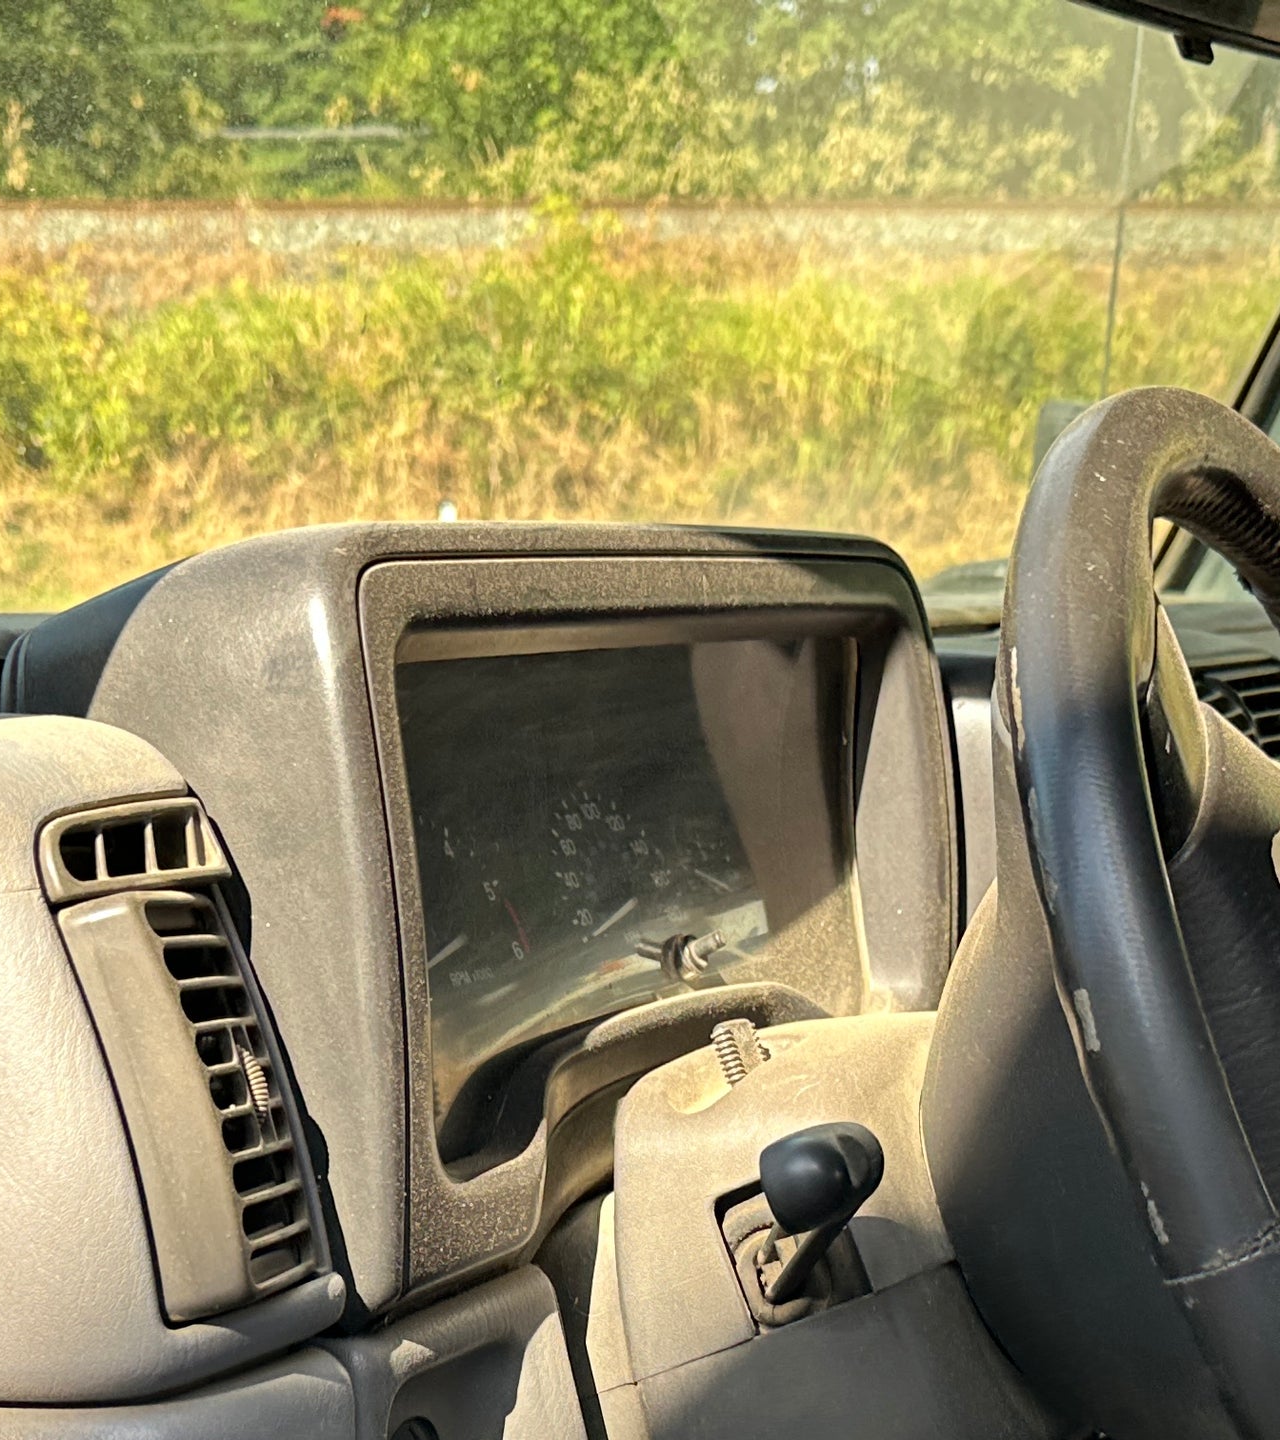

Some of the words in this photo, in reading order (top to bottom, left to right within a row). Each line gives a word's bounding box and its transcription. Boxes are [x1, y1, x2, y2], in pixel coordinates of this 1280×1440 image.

[581, 802, 600, 820] 100
[560, 838, 577, 857] 60
[482, 880, 496, 902] 5
[578, 908, 593, 927] 20
[512, 941, 524, 960] 6
[449, 970, 471, 988] RPM
